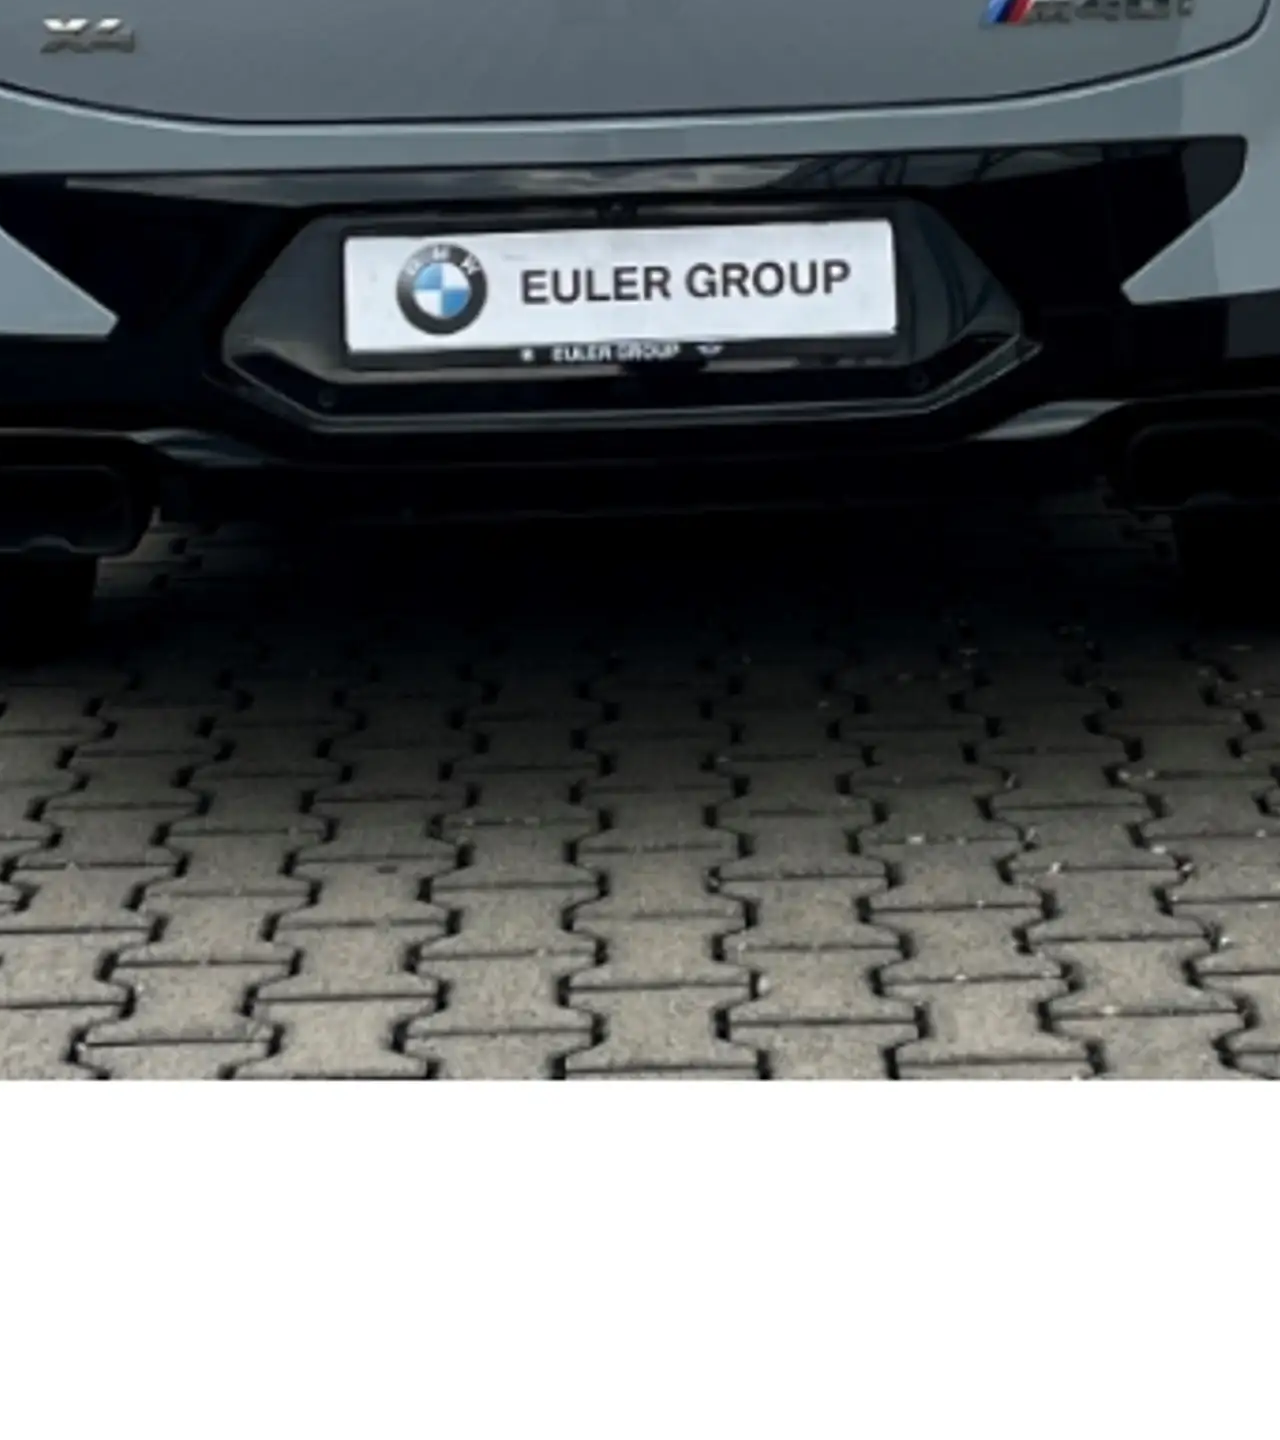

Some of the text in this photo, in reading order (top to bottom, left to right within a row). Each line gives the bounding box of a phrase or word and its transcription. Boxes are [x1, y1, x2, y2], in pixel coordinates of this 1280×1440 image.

[521, 259, 851, 305] EULER GROUP
[552, 344, 681, 363] EULER GROUP
